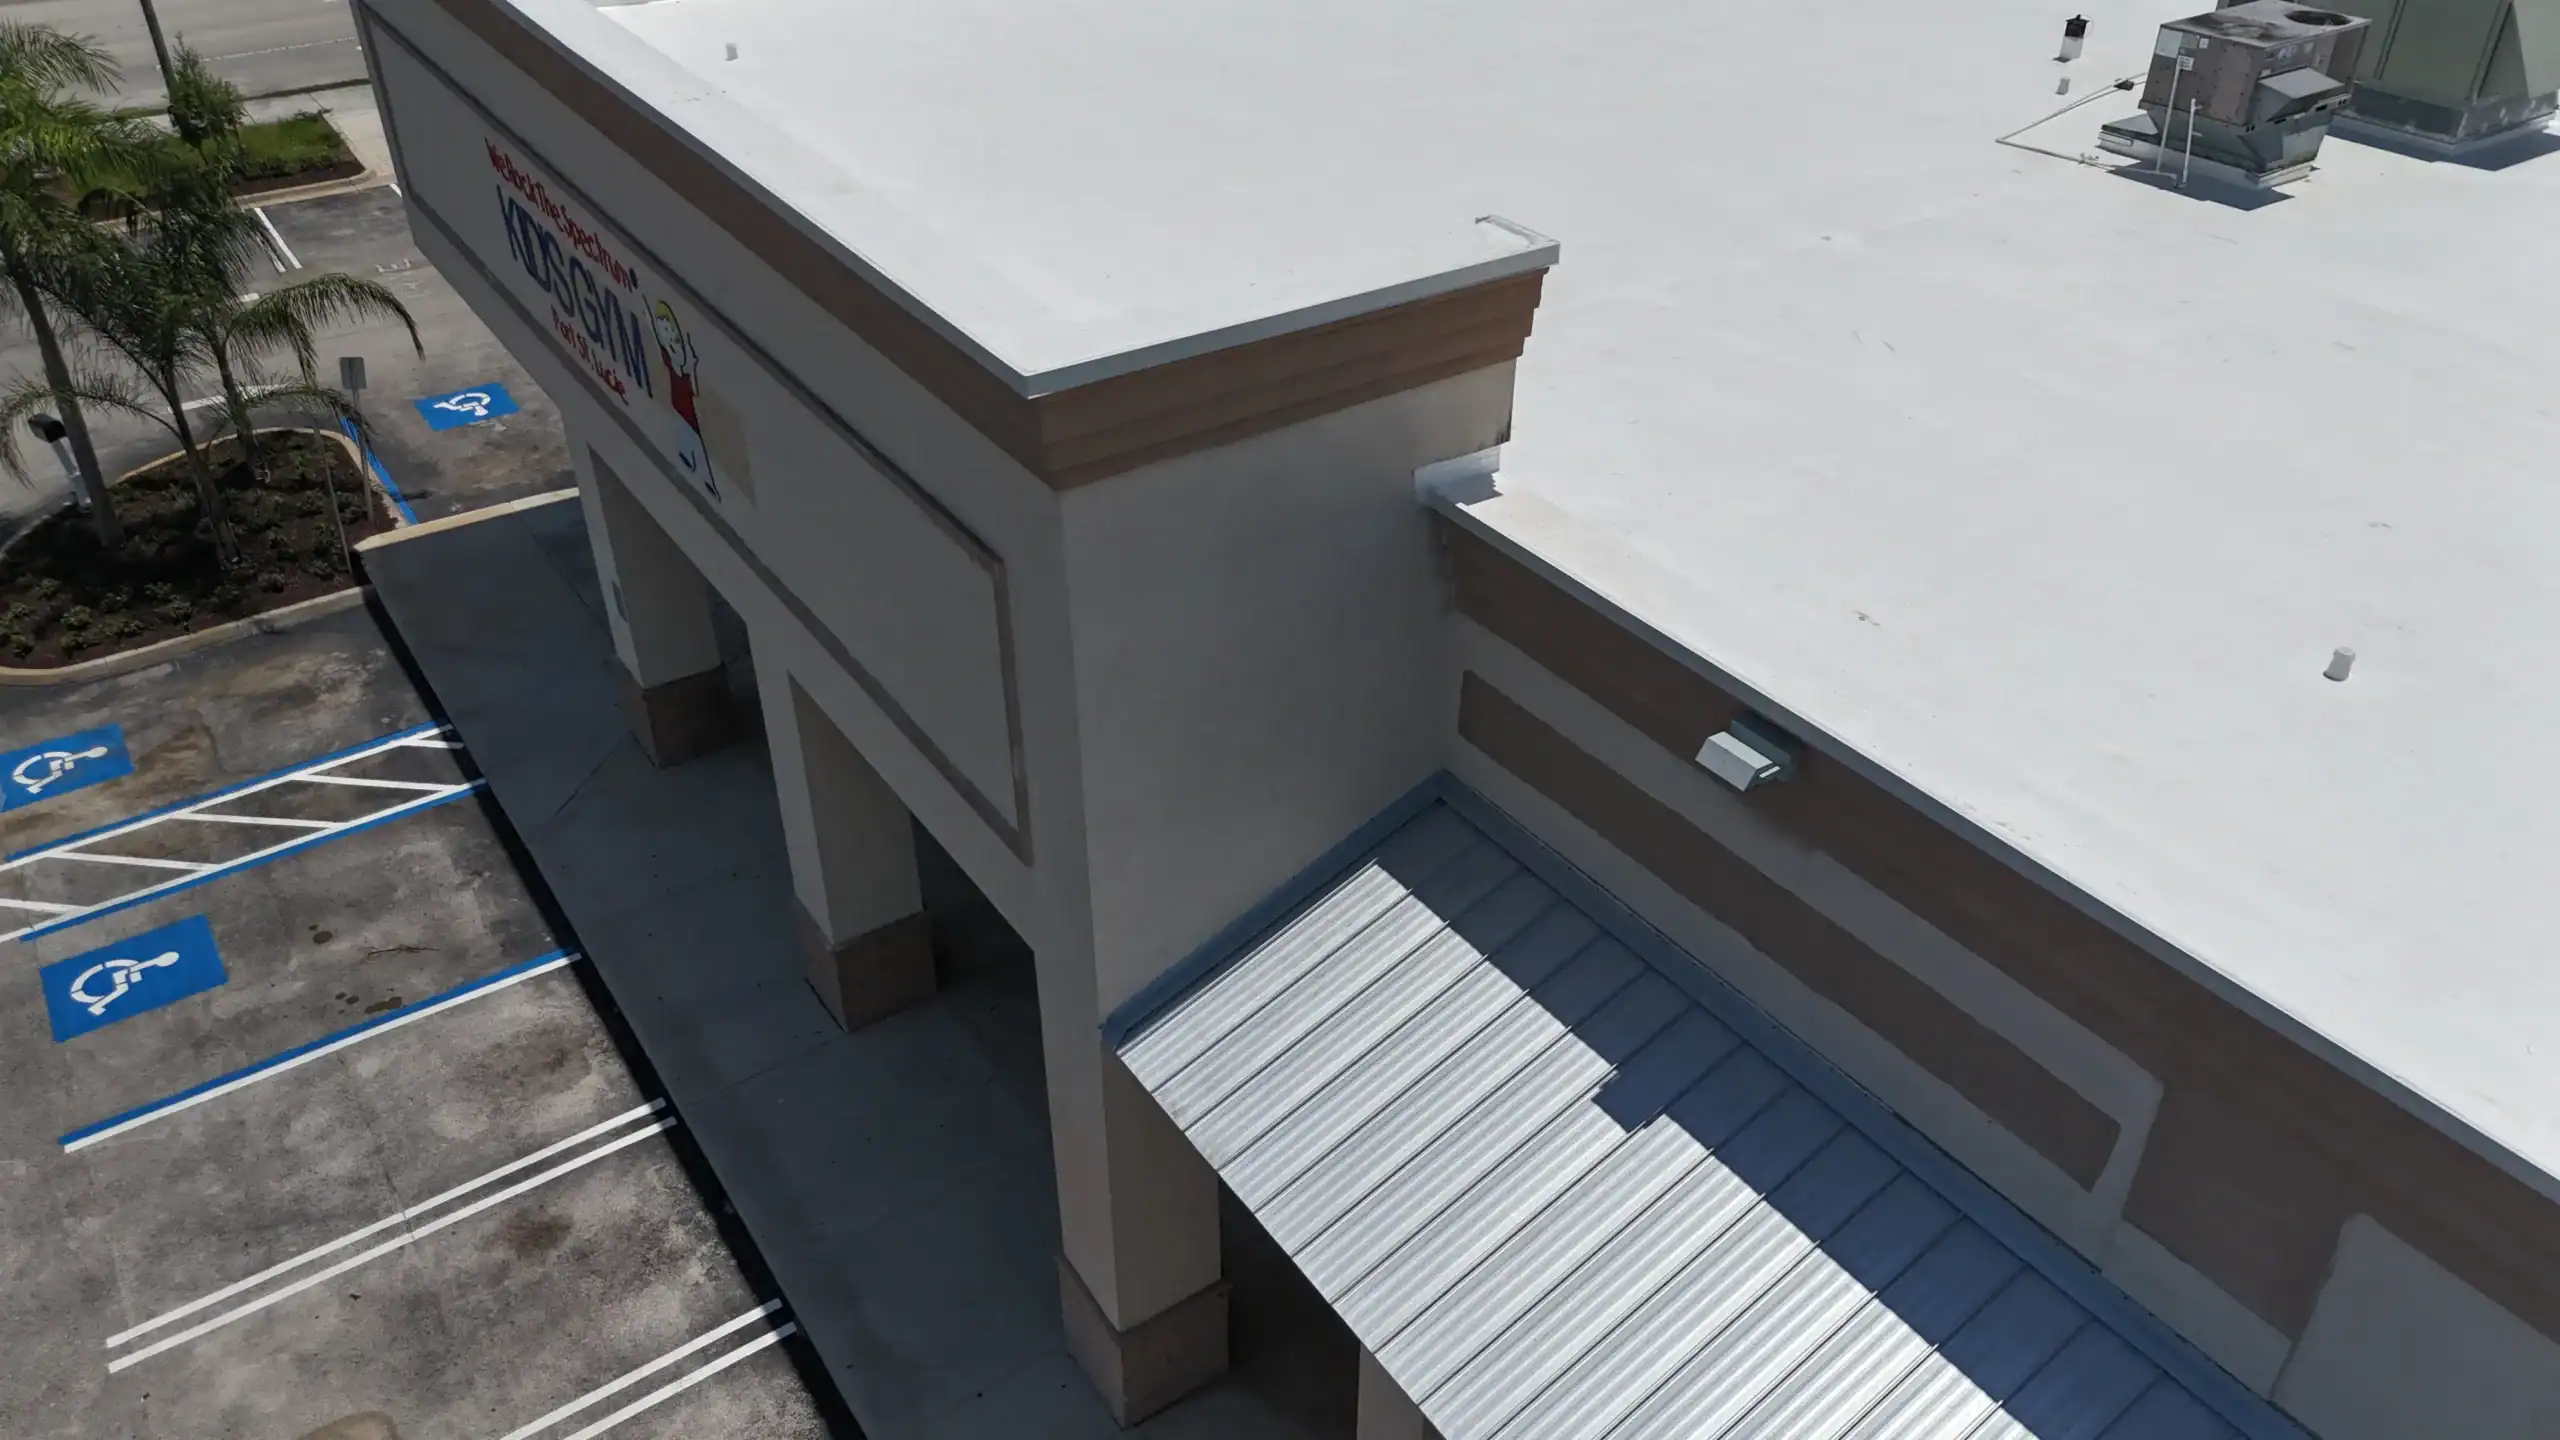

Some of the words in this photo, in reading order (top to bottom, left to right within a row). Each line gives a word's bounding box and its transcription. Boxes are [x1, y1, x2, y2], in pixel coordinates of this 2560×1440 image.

[504, 154, 539, 207] Rock
[535, 182, 565, 232] The
[550, 303, 577, 348] Port
[591, 347, 630, 406] Lucie
[569, 256, 653, 400] GYM
